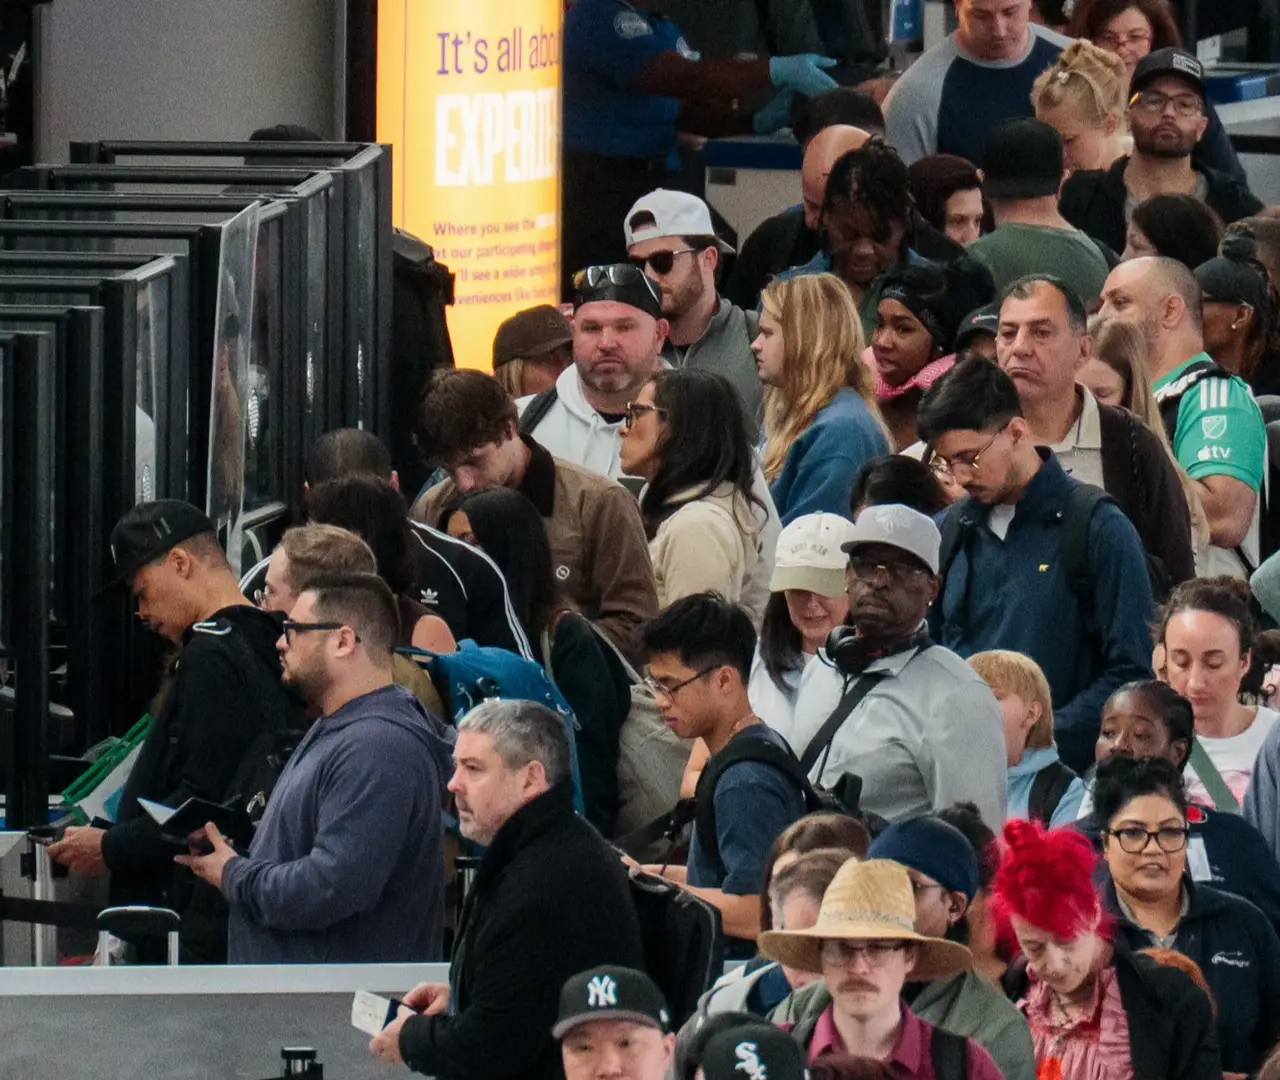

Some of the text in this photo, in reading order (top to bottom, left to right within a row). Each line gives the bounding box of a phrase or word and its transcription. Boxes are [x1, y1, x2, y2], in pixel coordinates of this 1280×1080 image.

[436, 24, 560, 75] It's all abo
[433, 220, 477, 236] Where
[480, 222, 500, 236] you
[451, 249, 472, 259] our
[587, 974, 618, 1007] NY
